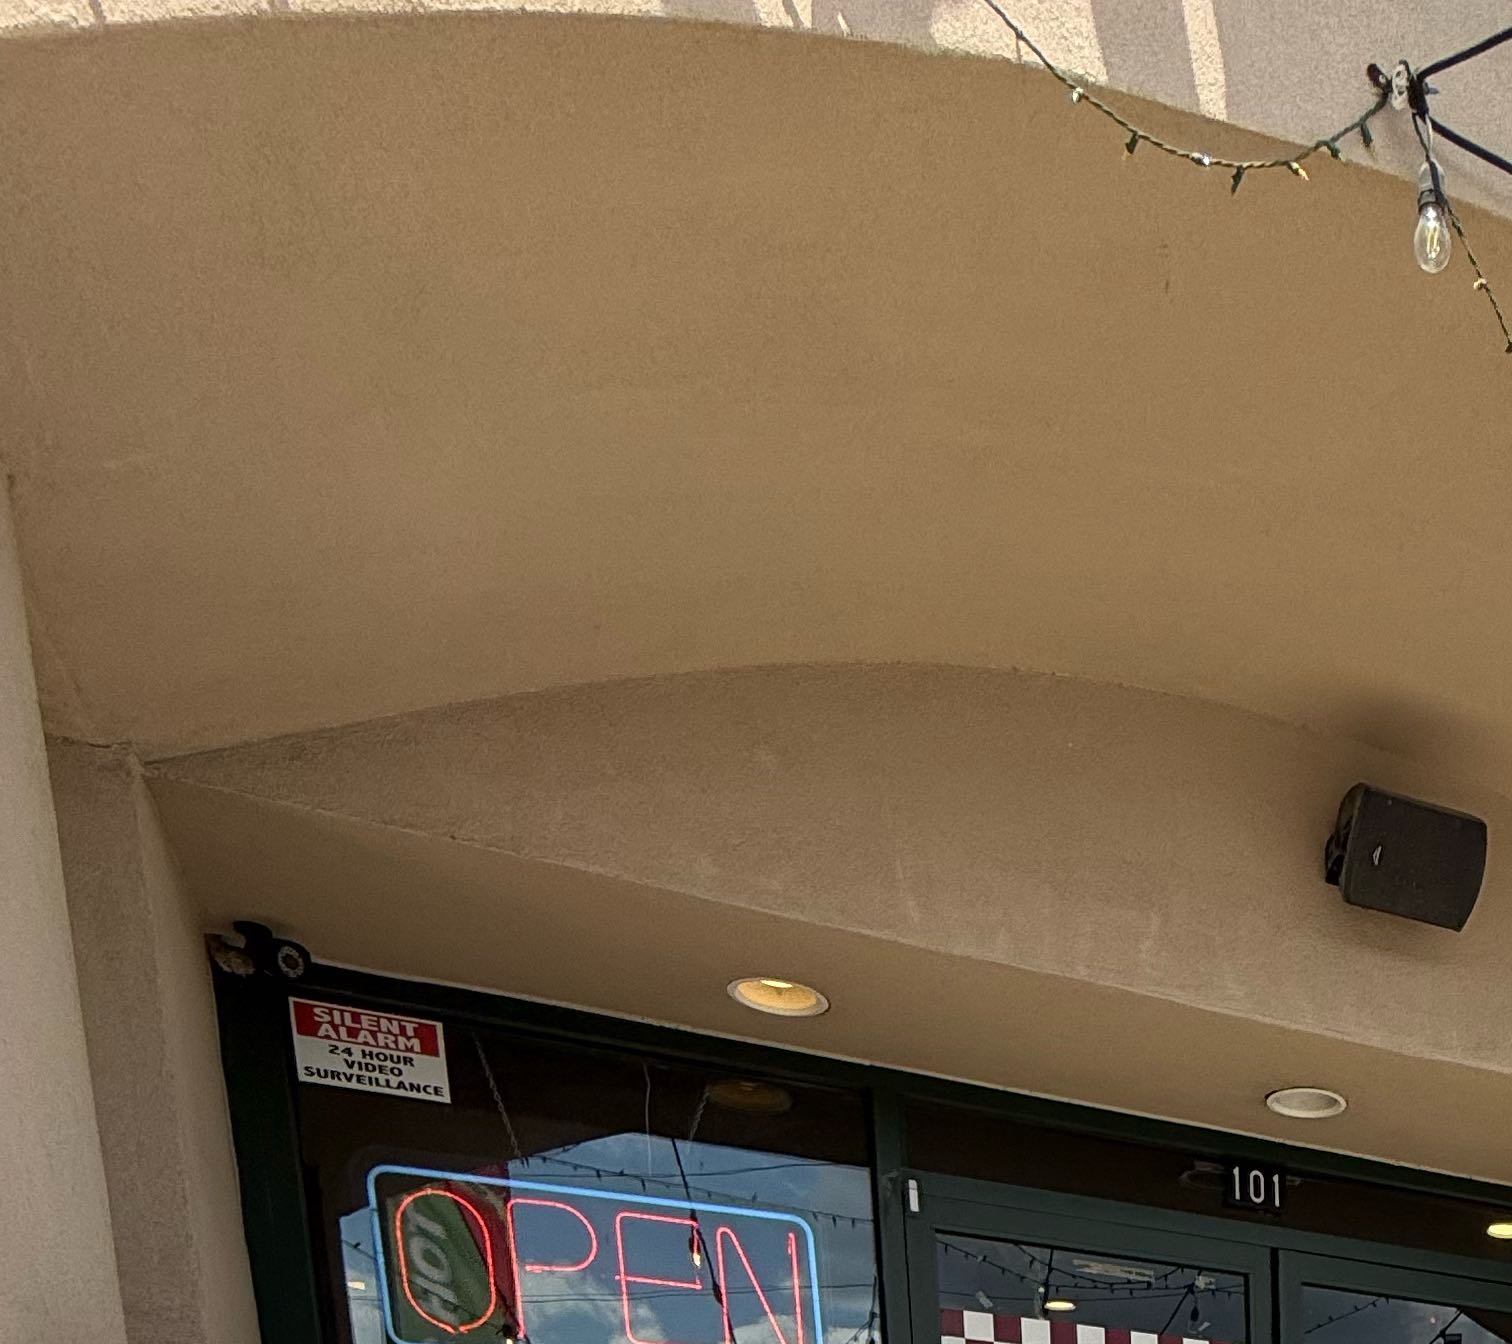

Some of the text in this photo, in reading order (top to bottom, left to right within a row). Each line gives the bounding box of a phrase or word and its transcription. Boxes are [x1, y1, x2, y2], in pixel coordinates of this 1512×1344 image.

[313, 1007, 418, 1037] SILENT
[317, 1023, 421, 1053] ALARM
[328, 1044, 415, 1068] 24 HOUR
[343, 1058, 403, 1077] VIDEO
[303, 1066, 445, 1097] SURVEILLANCE
[1233, 1166, 1280, 1208] 101
